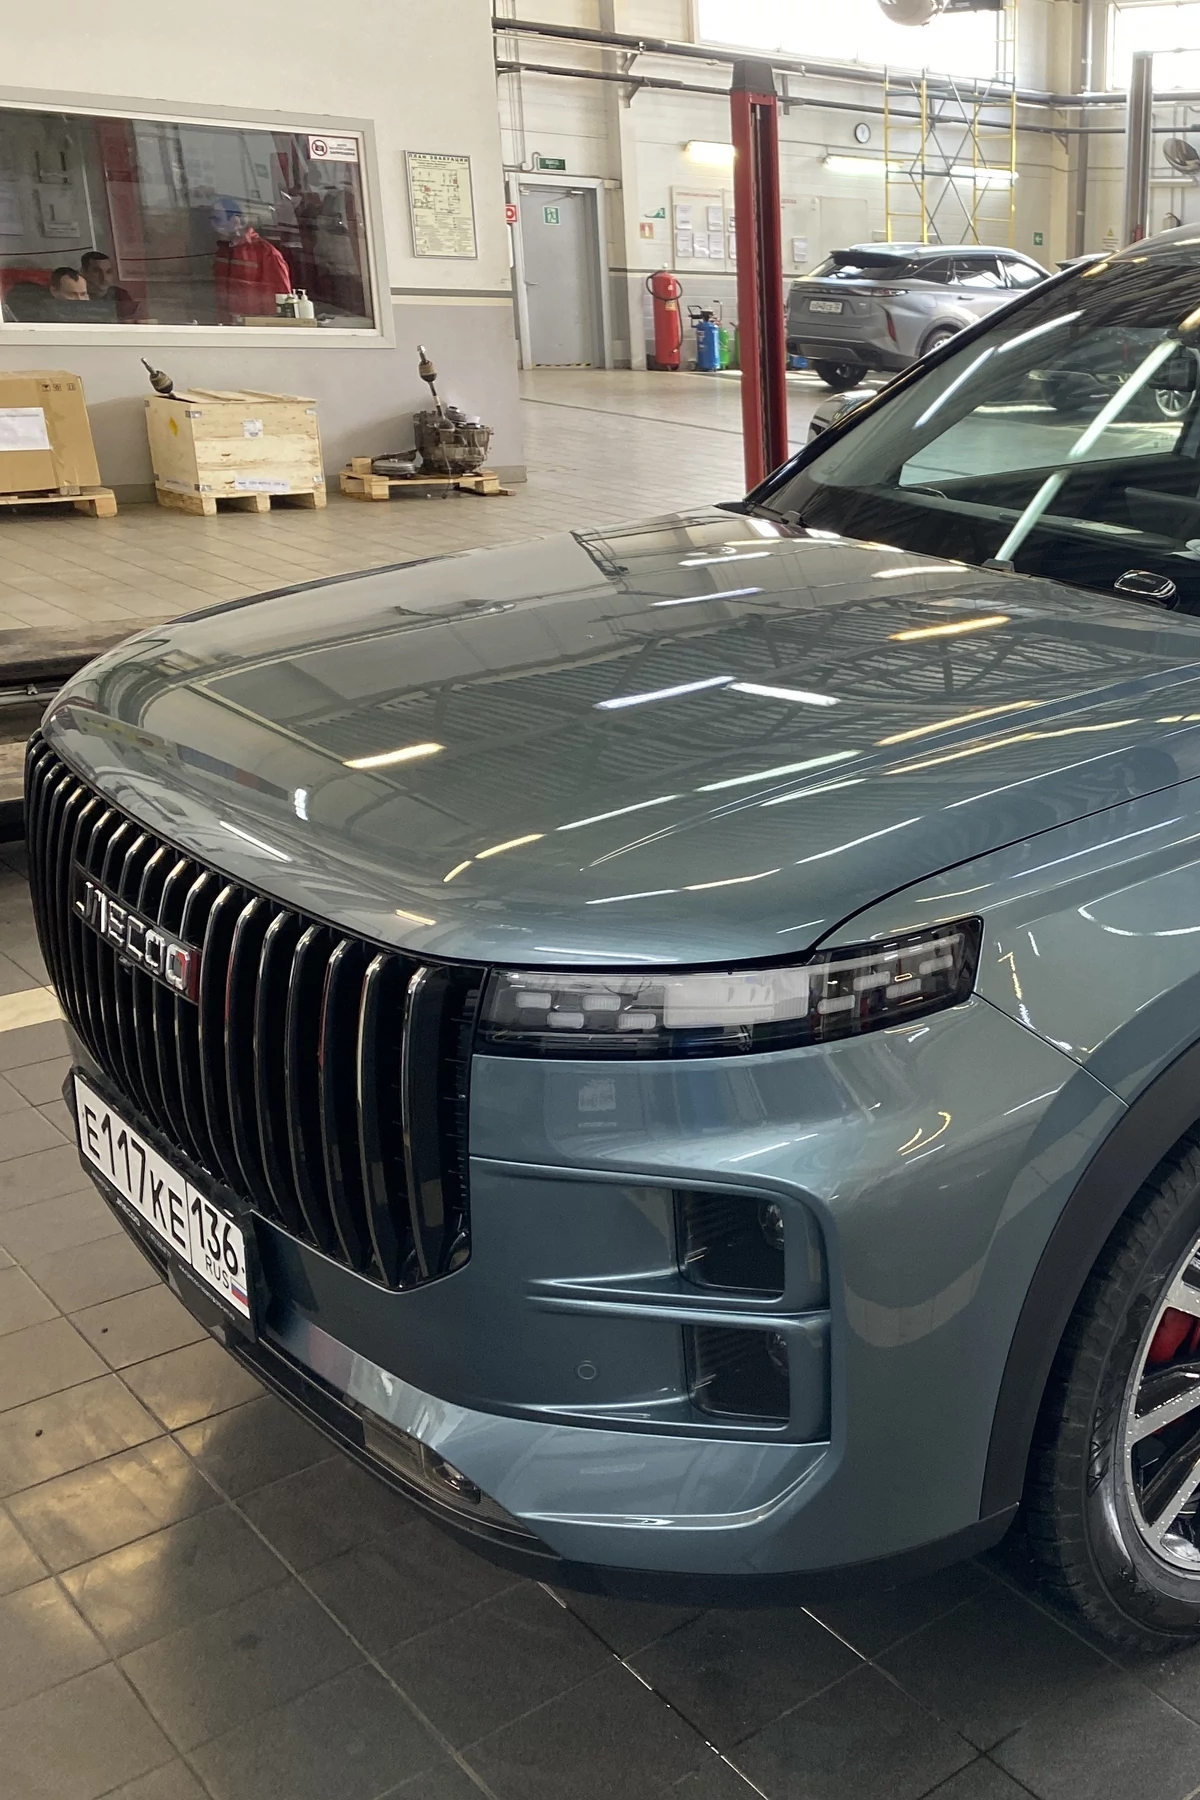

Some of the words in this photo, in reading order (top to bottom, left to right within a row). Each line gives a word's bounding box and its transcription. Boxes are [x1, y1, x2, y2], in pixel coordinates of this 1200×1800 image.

[75, 881, 191, 991] JAECOO
[84, 1104, 187, 1250] E117KE
[190, 1196, 240, 1276] 136
[205, 1253, 230, 1290] RUS
